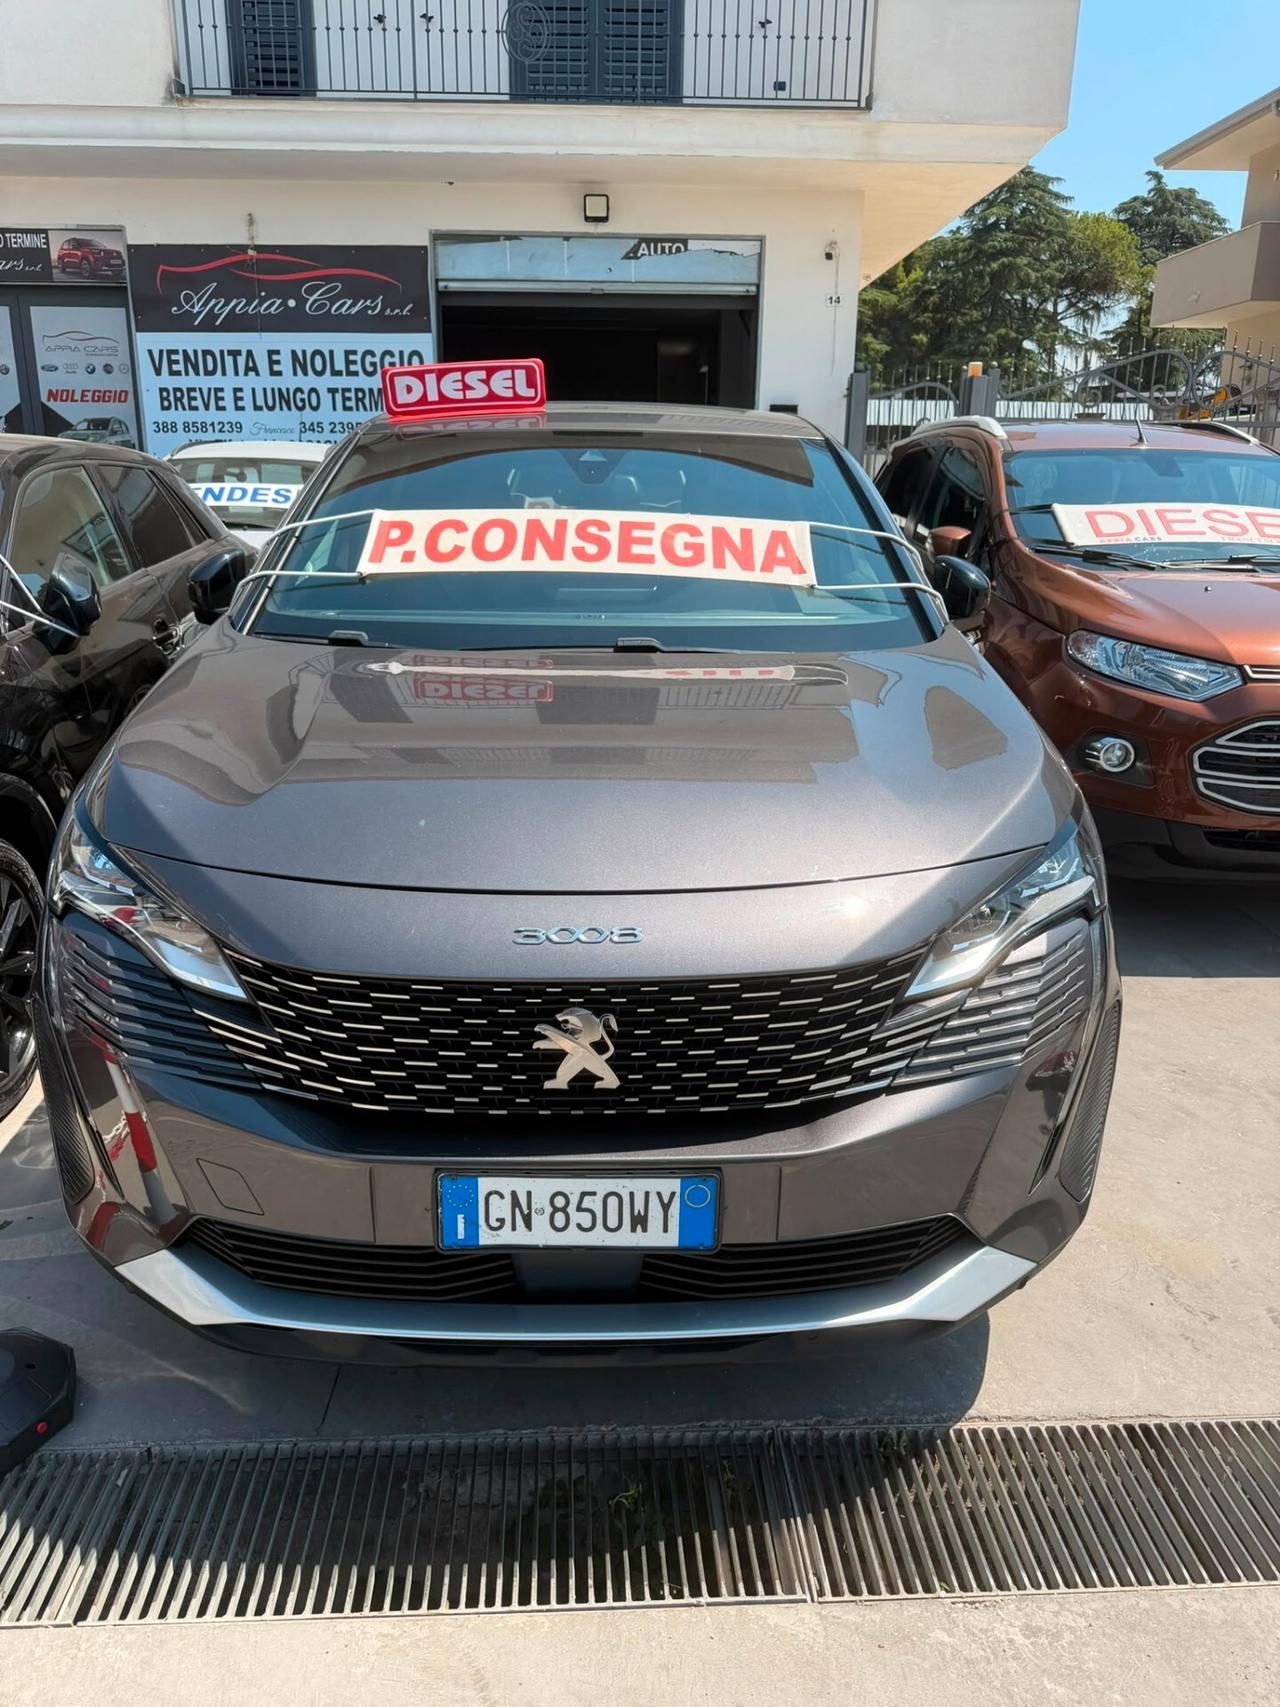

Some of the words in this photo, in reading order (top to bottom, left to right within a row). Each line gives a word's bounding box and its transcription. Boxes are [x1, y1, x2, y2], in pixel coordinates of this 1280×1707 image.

[5, 233, 47, 248] TERMINE
[637, 242, 685, 257] AUTO
[171, 282, 284, 325] Appia
[301, 281, 383, 315] Cars
[828, 296, 840, 304] 14
[83, 345, 119, 353] CARS
[147, 349, 260, 377] VENDITA
[267, 349, 284, 377] E
[291, 349, 424, 377] NOLEGGIO
[394, 369, 536, 404] DIESEL
[47, 389, 129, 403] NOLEGGIO
[158, 387, 227, 411] BREVE
[233, 387, 246, 411] E
[251, 387, 321, 412] LUNGO
[153, 421, 178, 434] 388
[182, 421, 243, 434] 8581239
[250, 421, 296, 436] Francesco
[299, 421, 324, 434] 345
[192, 487, 293, 504] NDES
[1085, 509, 1280, 539] DIESE
[368, 518, 807, 575] P.CONSEGNA
[512, 926, 644, 945] 3008
